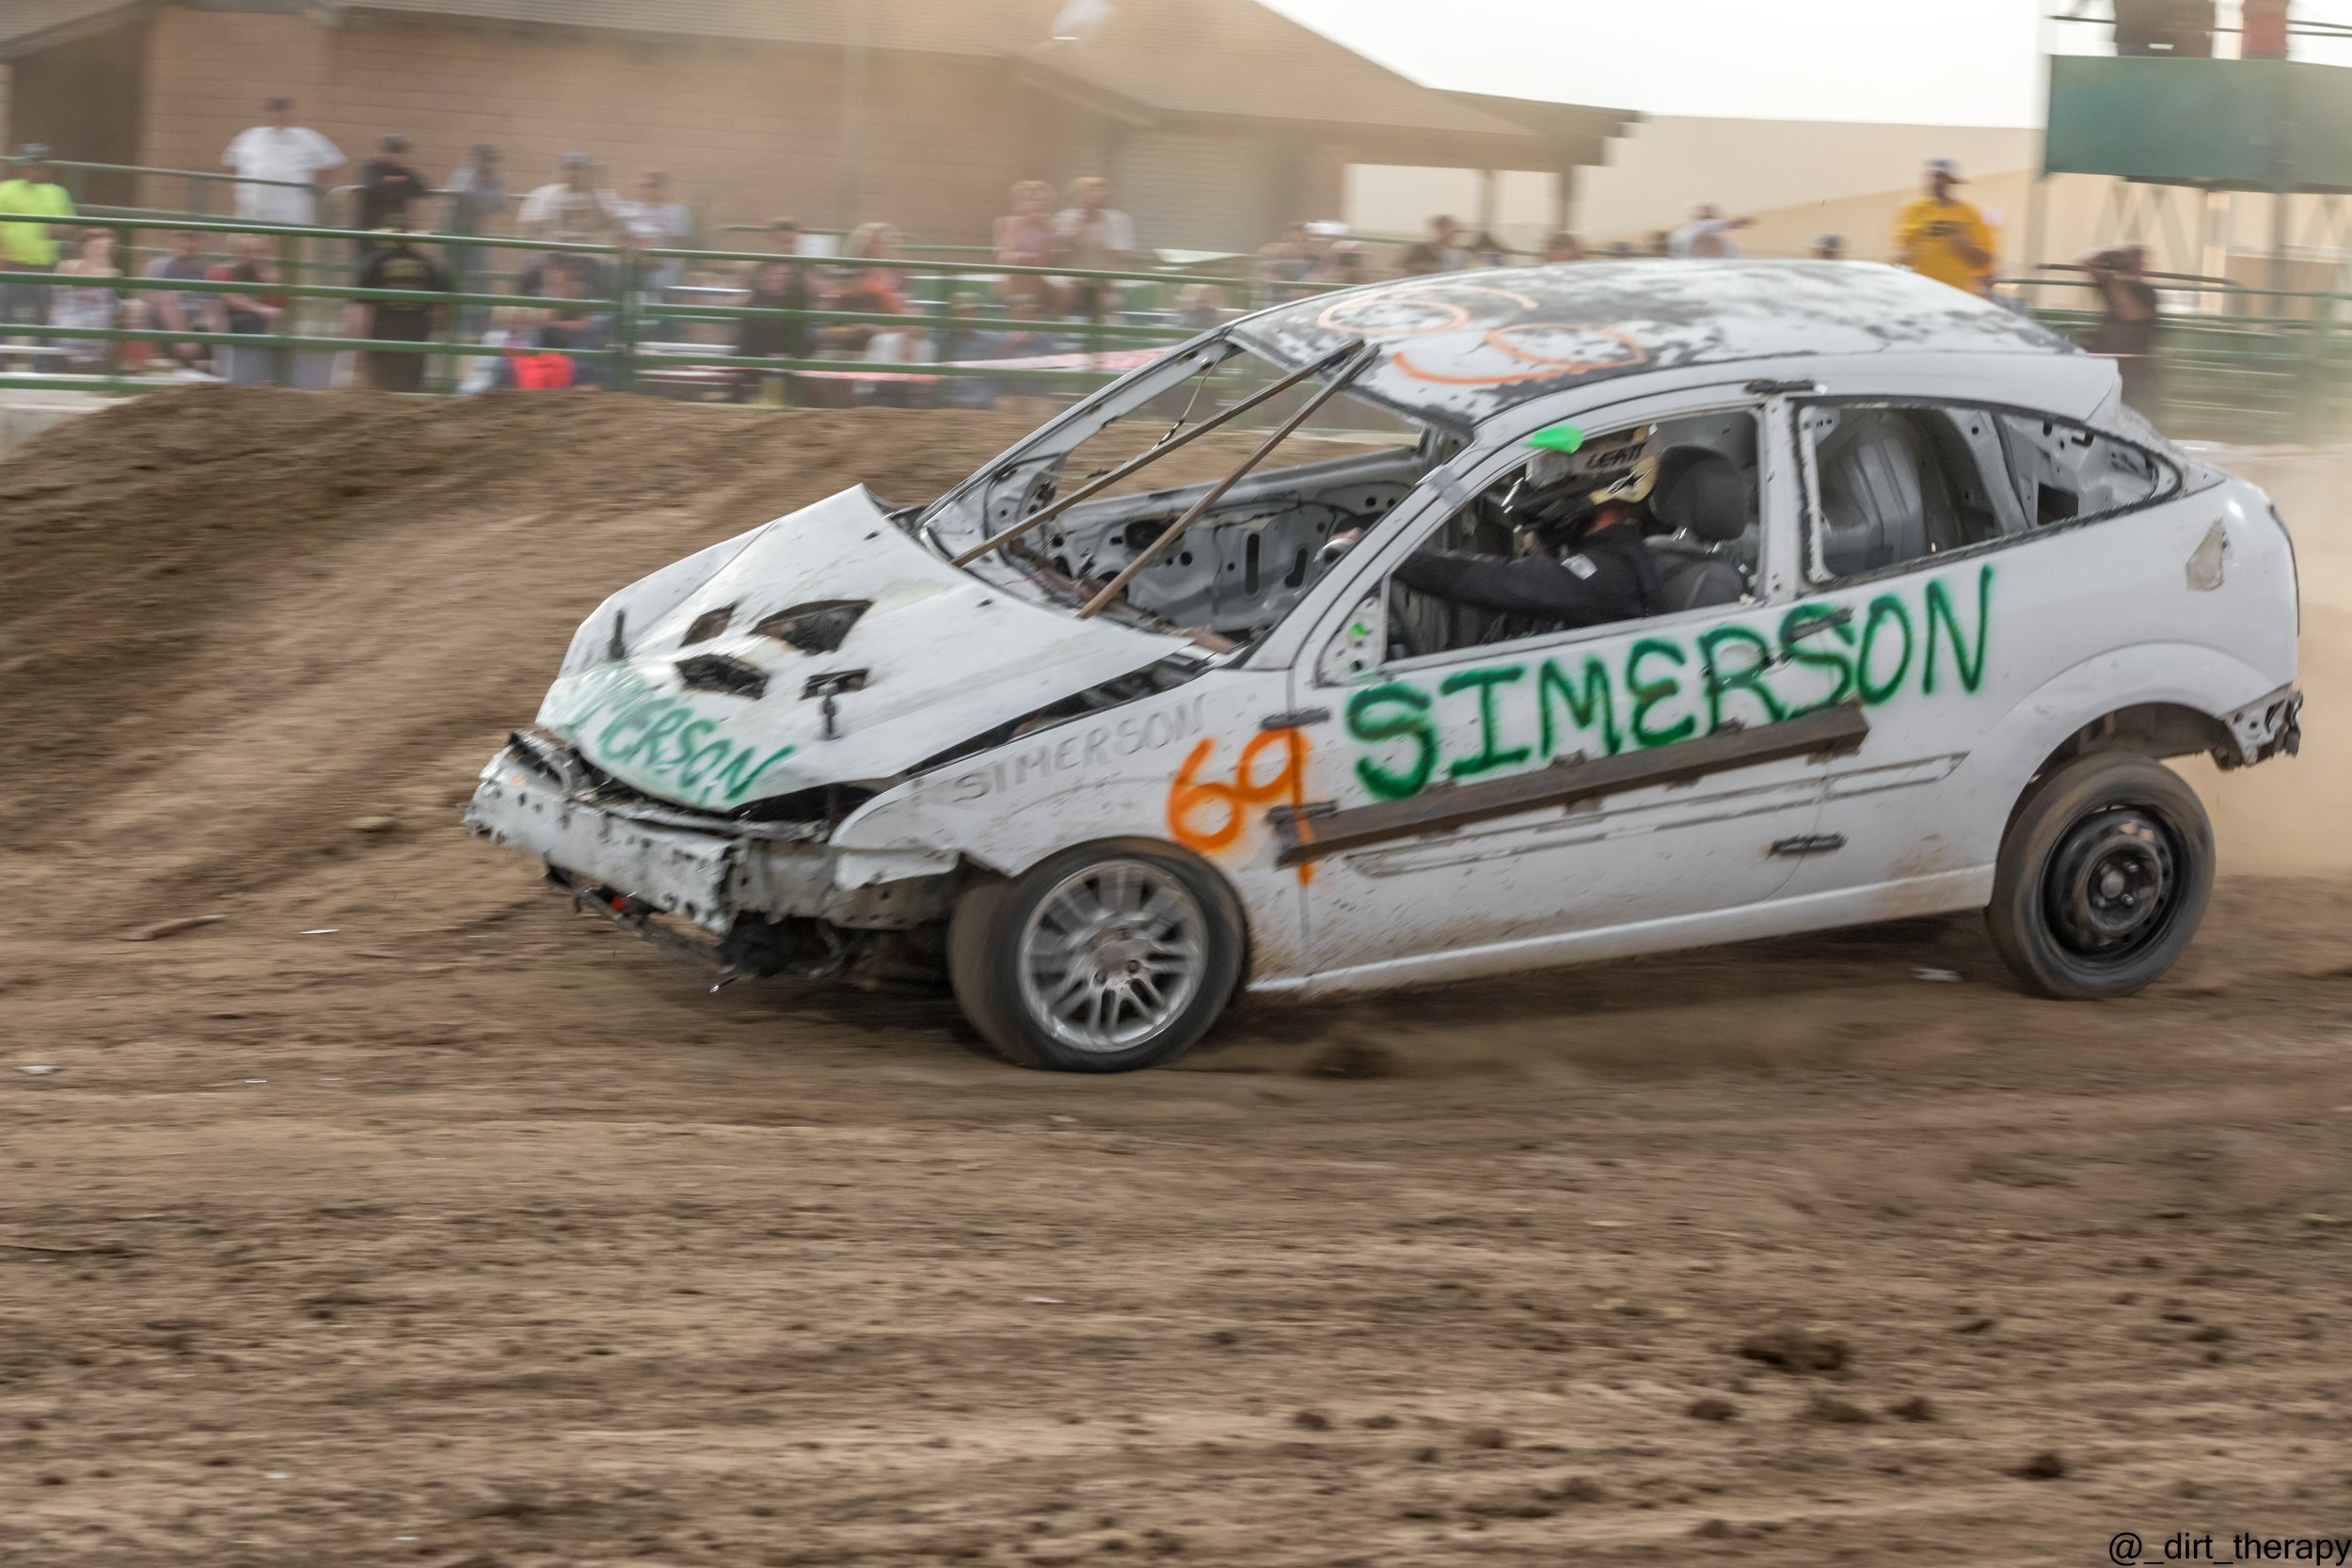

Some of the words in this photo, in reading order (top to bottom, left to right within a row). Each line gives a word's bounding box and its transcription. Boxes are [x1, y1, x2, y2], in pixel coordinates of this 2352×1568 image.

[540, 657, 796, 805] MERSON
[954, 692, 1208, 802] SIMERSON
[1344, 564, 1993, 800] SIMERSON
[1166, 725, 1314, 887] 69
